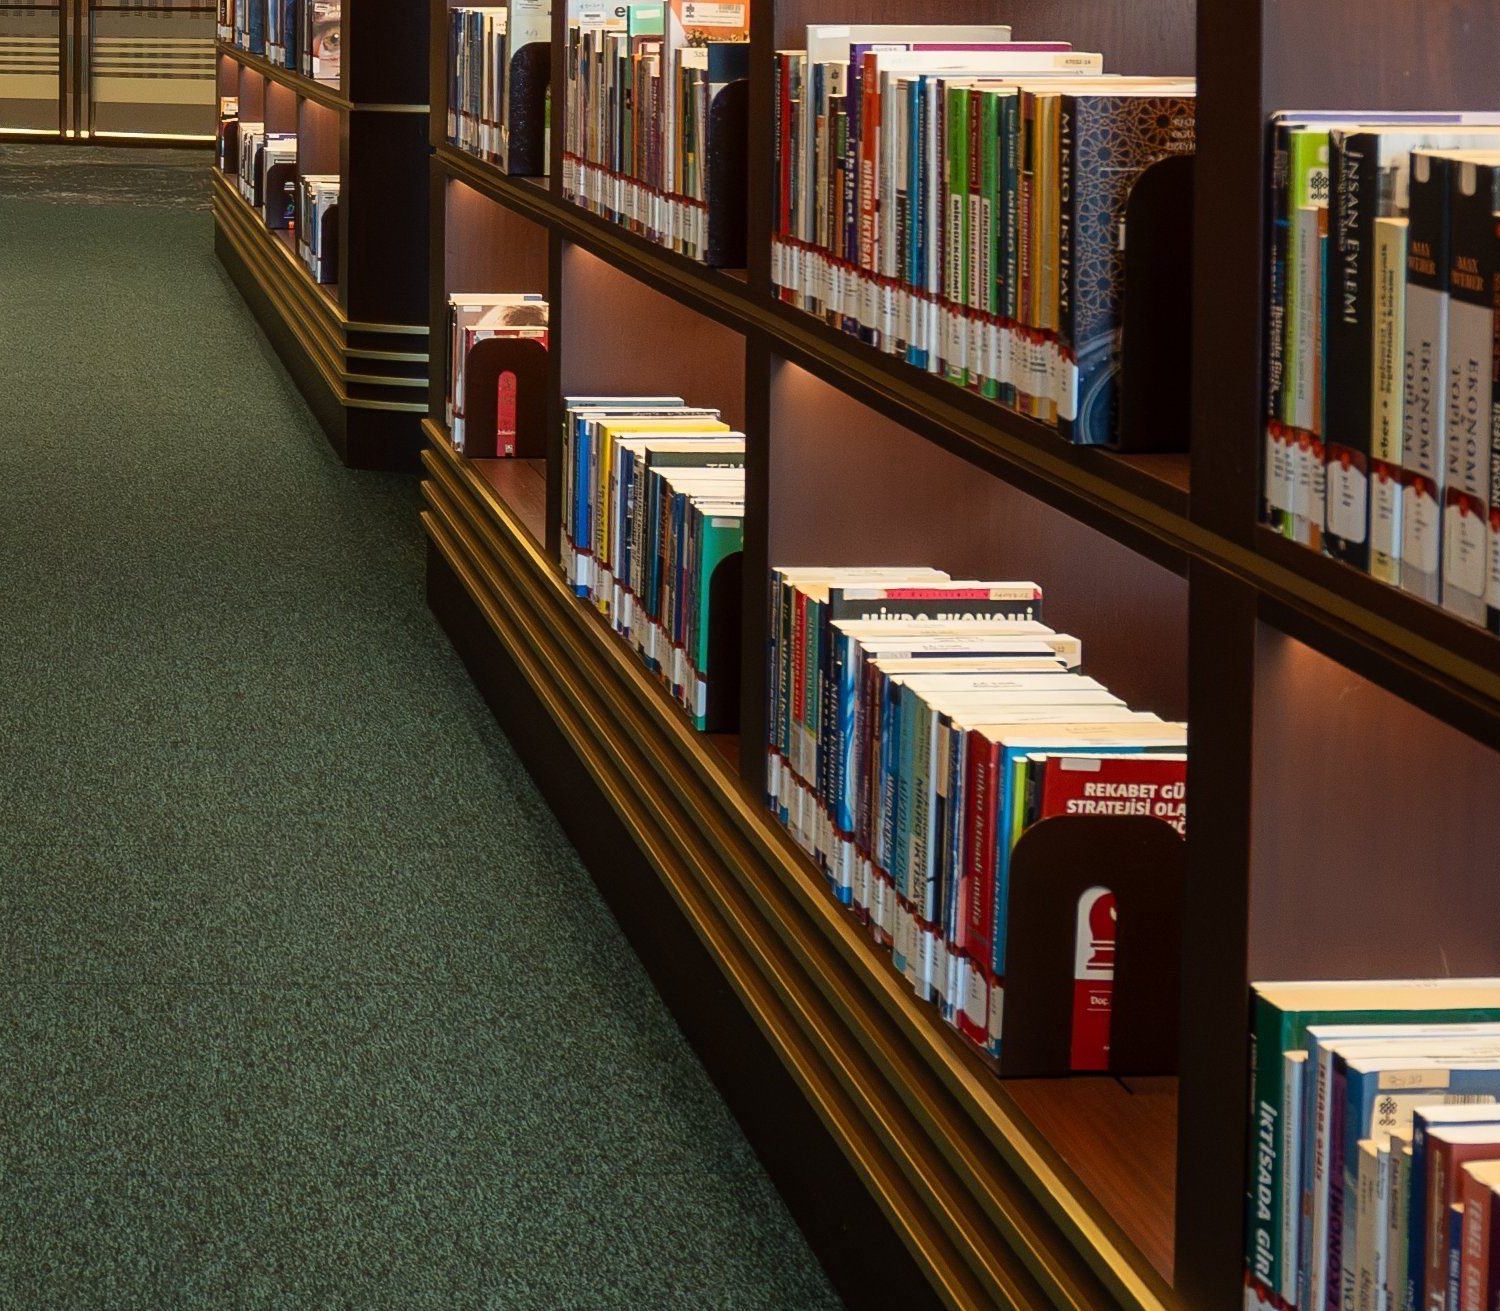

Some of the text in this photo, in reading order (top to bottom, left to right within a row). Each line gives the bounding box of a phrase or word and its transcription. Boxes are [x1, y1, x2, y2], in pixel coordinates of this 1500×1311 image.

[862, 160, 873, 211] MİKRO
[1060, 112, 1073, 313] MİKRO İKTİSAT
[952, 199, 961, 301] MİKROEKONOMİY
[982, 203, 990, 311] MİKROEKONOMİY
[1007, 190, 1016, 317] MİKRO İKTİSA
[1403, 347, 1416, 452] TOPLUM
[1417, 338, 1432, 469] EKONOMİ
[1448, 364, 1462, 475] TOPLUM
[911, 777, 923, 900] MİKRO İKTİSA
[1066, 799, 1186, 816] STRATEJİSİ OLA
[1083, 782, 1186, 799] REKABET GÜ
[1257, 1100, 1278, 1222] İKTİSADA
[1466, 1199, 1483, 1259] TEMEL
